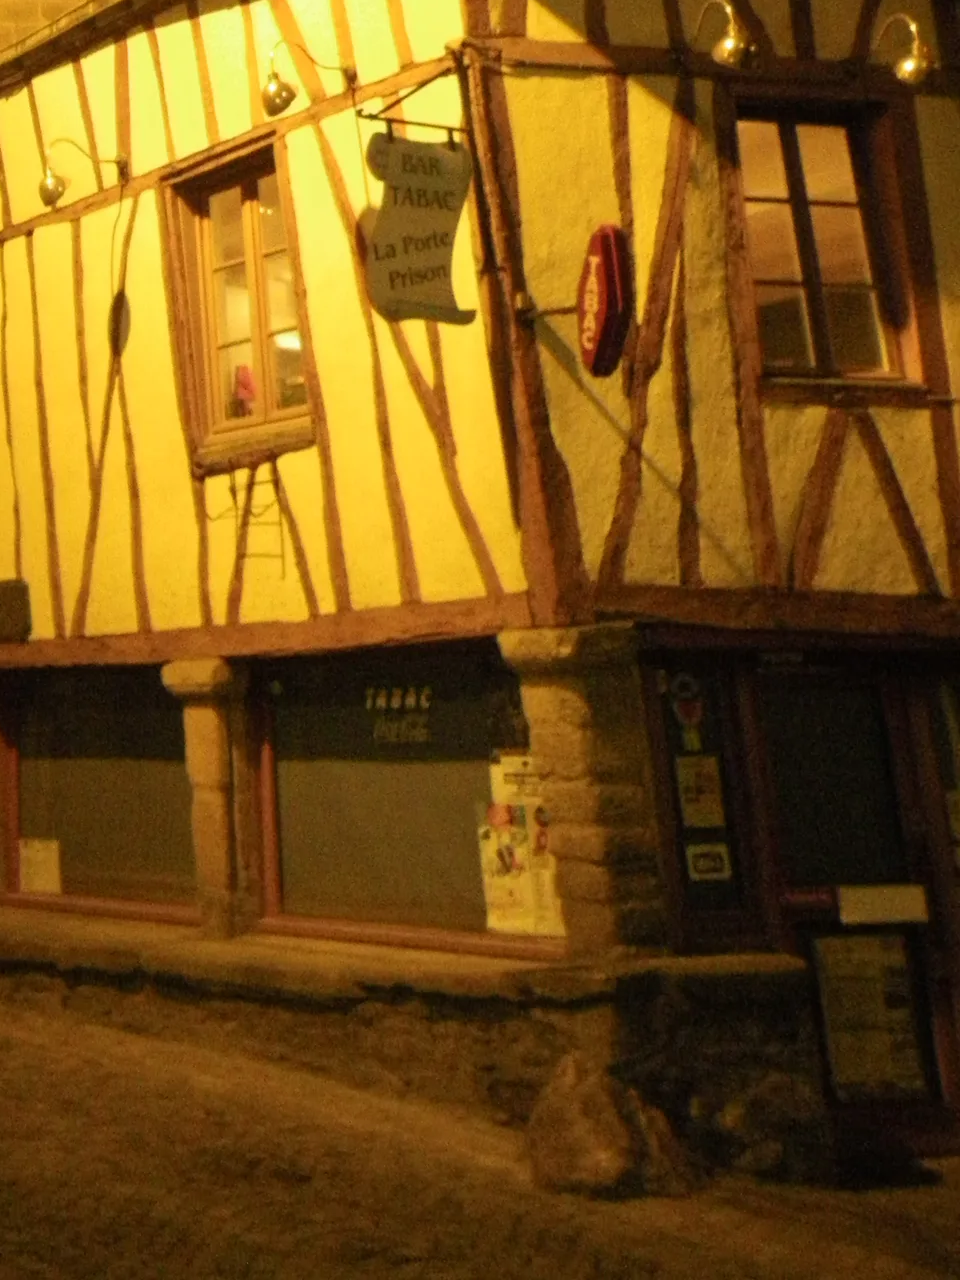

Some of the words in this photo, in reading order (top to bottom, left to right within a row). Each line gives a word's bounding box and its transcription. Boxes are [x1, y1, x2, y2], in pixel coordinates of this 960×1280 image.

[401, 153, 441, 177] BAR
[391, 185, 456, 211] TABAC
[373, 243, 397, 261] La
[402, 231, 451, 256] Porte
[388, 265, 447, 291] Prison
[581, 255, 601, 351] TABAC
[365, 685, 432, 711] TABAC
